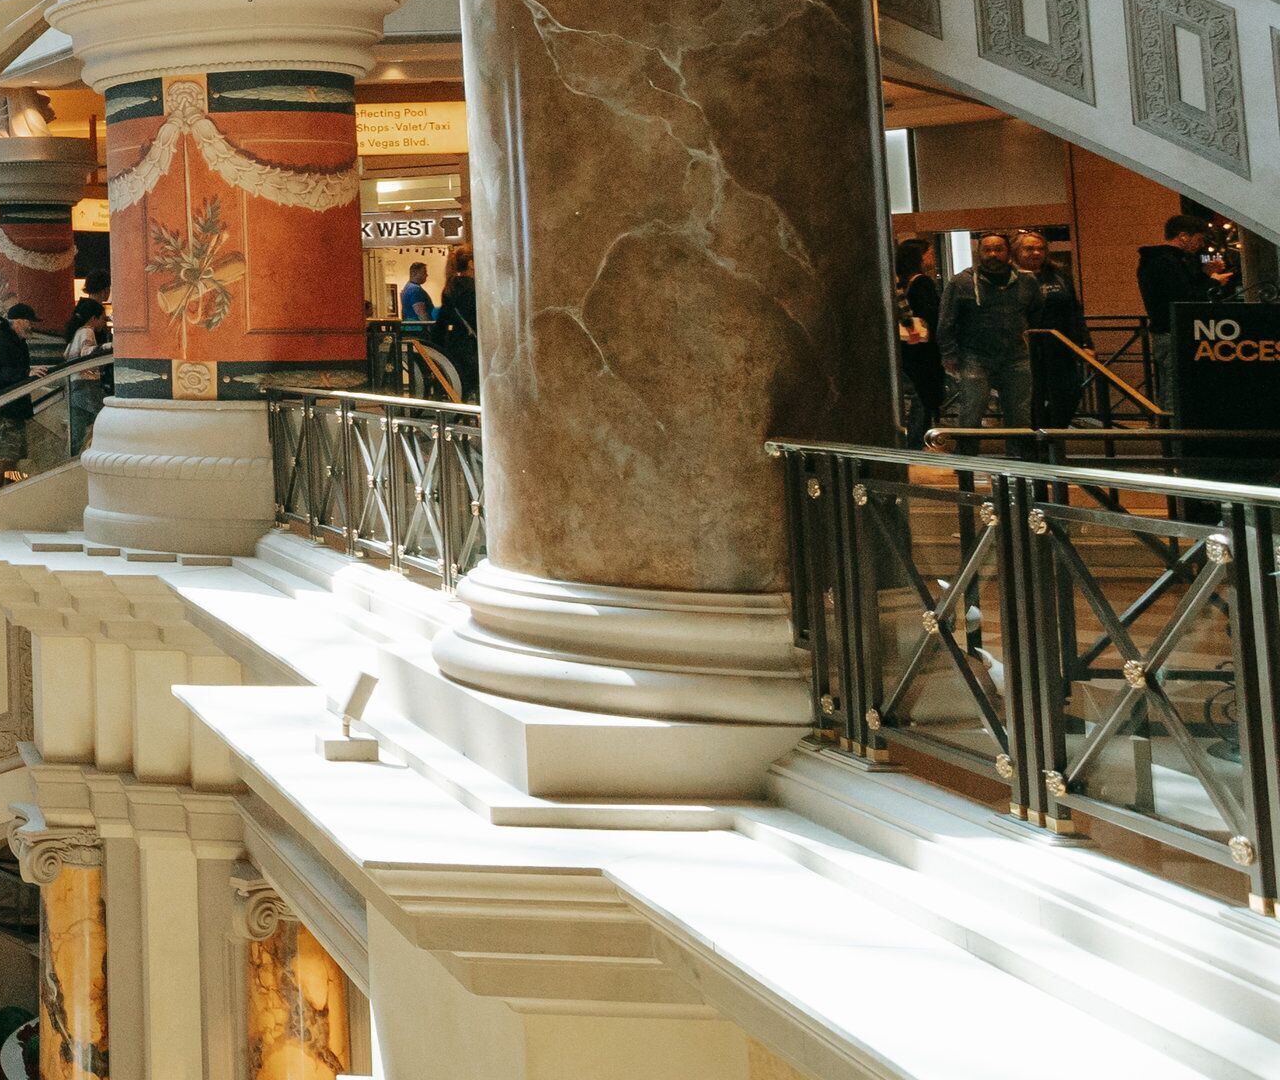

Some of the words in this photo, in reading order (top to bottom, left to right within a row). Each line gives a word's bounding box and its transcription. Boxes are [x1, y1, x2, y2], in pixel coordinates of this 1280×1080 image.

[404, 108, 427, 117] Pool
[356, 123, 389, 133] Shops
[395, 121, 451, 132] Valet/Taxi
[368, 139, 400, 149] Vegas
[403, 137, 430, 147] Blvd.
[377, 220, 434, 238] WEST
[1193, 319, 1240, 340] NO
